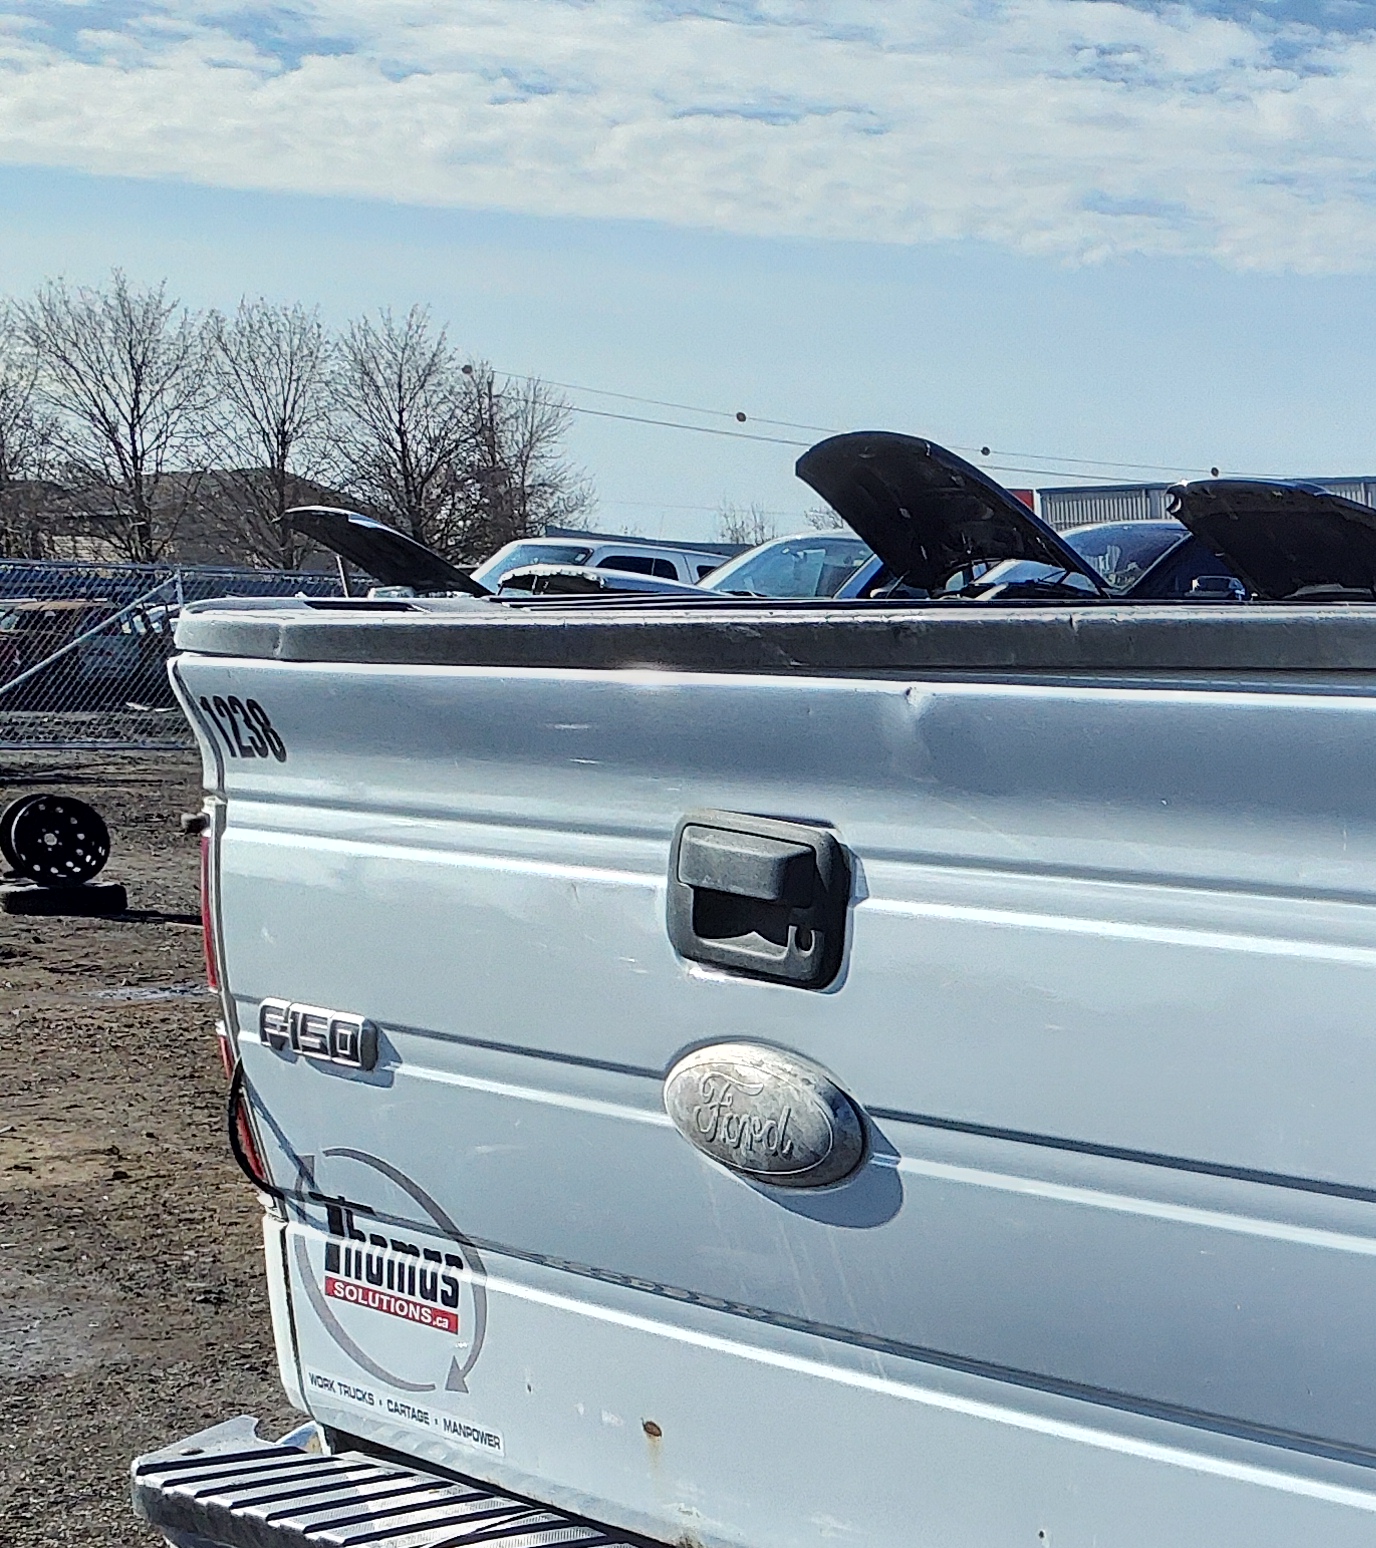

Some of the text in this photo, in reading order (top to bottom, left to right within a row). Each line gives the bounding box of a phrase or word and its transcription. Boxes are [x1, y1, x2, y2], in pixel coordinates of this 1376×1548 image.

[200, 695, 287, 762] 1238
[695, 1071, 796, 1160] Ford
[308, 1191, 464, 1309] Thomas
[333, 1281, 450, 1330] SOLUTIONS.ca
[309, 1372, 501, 1450] WORK TRUCKS CARTAGE MANPOWER
